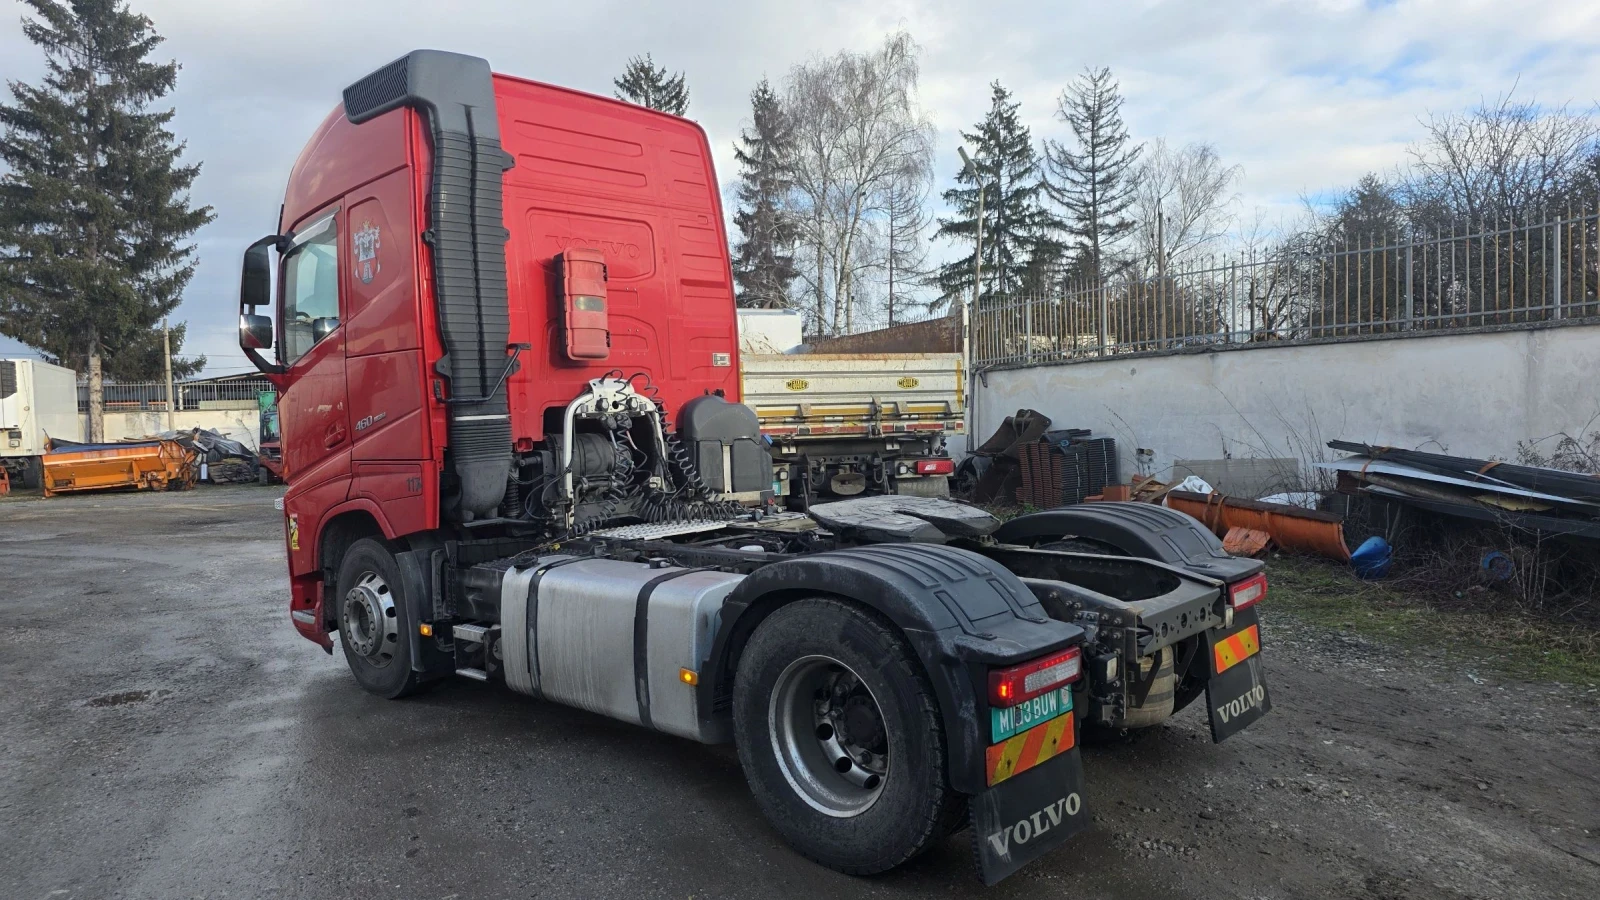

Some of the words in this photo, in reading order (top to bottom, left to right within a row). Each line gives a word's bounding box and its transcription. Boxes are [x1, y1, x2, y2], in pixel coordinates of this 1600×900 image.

[355, 415, 373, 430] 460
[1217, 684, 1265, 724] VOLVO
[988, 792, 1080, 856] VOLVO
